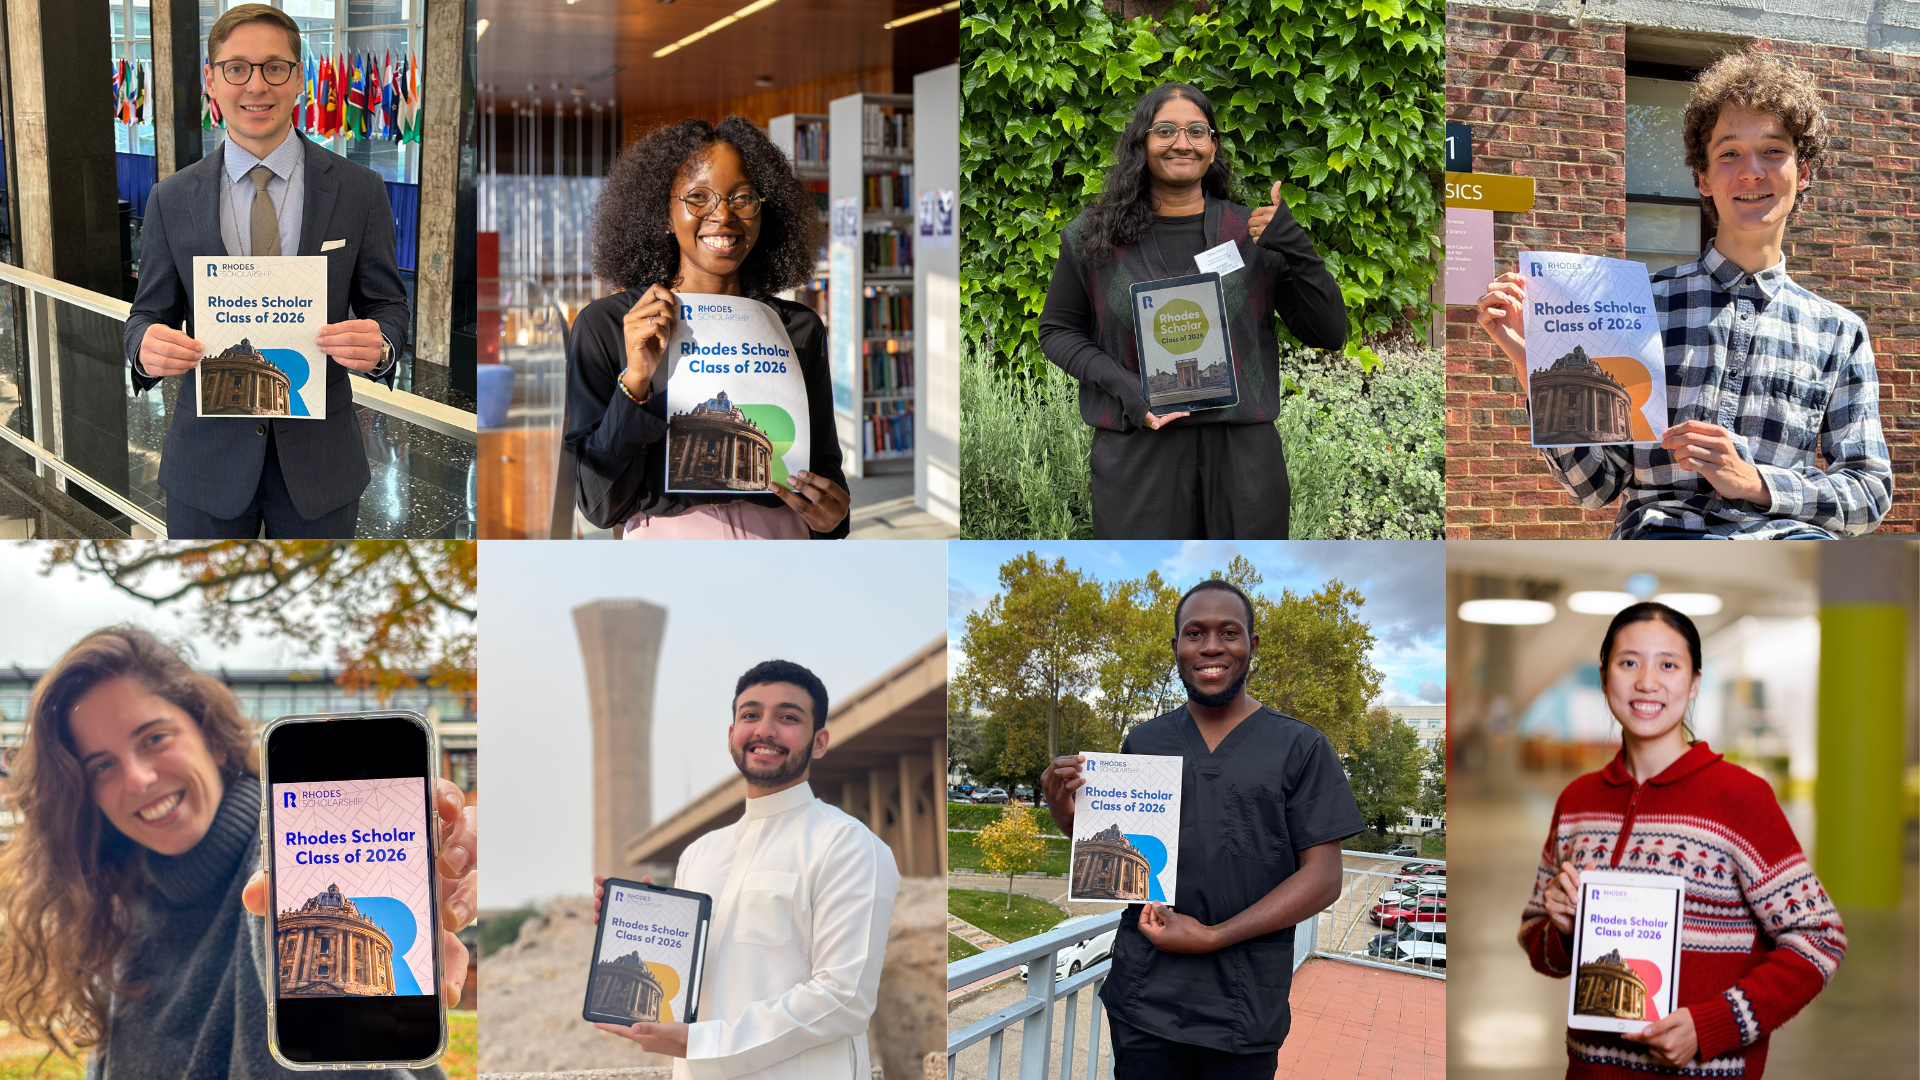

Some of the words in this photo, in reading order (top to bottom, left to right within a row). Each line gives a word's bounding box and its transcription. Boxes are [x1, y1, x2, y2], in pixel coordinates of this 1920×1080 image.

[1446, 184, 1482, 200] SICS
[1548, 262, 1582, 270] RHODES
[208, 296, 258, 307] Rhodes
[262, 296, 312, 308] Scholar
[1535, 301, 1590, 315] Rhodes
[1594, 300, 1646, 315] Scholar
[698, 305, 732, 313] RHODES
[216, 312, 251, 323] Class
[256, 312, 269, 323] of
[272, 312, 305, 323] 2026
[698, 313, 749, 321] SCHOLARSHIP
[1160, 310, 1200, 323] Rhodes
[1160, 321, 1202, 334] Scholar
[1544, 320, 1584, 333] Class
[1588, 318, 1603, 331] of
[1607, 318, 1642, 330] 2026
[681, 342, 737, 355] Rhodes
[742, 342, 790, 357] Scholar
[689, 360, 730, 374] Class
[734, 360, 750, 374] of
[754, 361, 786, 373] 2026
[302, 790, 341, 798] RHODES
[1085, 787, 1128, 798] Rhodes
[1131, 789, 1173, 800] Scholar
[302, 798, 363, 808] SCHOLARSHIP
[1091, 800, 1121, 811] Class
[1124, 802, 1136, 812] of
[1138, 803, 1166, 813] 2026
[286, 831, 347, 846] Rhodes
[352, 828, 416, 843] Scholar
[296, 851, 339, 865] Class
[344, 849, 361, 863] of
[366, 848, 407, 862] 2026
[627, 893, 651, 901] RHODES
[612, 917, 648, 932] Rhodes
[651, 924, 689, 938] Scholar
[1590, 914, 1627, 925] Rhodes
[1630, 917, 1668, 928] Scholar
[616, 930, 642, 942] Class
[645, 935, 656, 944] of
[658, 937, 682, 948] 2026
[1595, 926, 1622, 937] Class
[1624, 929, 1635, 938] of
[1637, 930, 1662, 940] 2026
